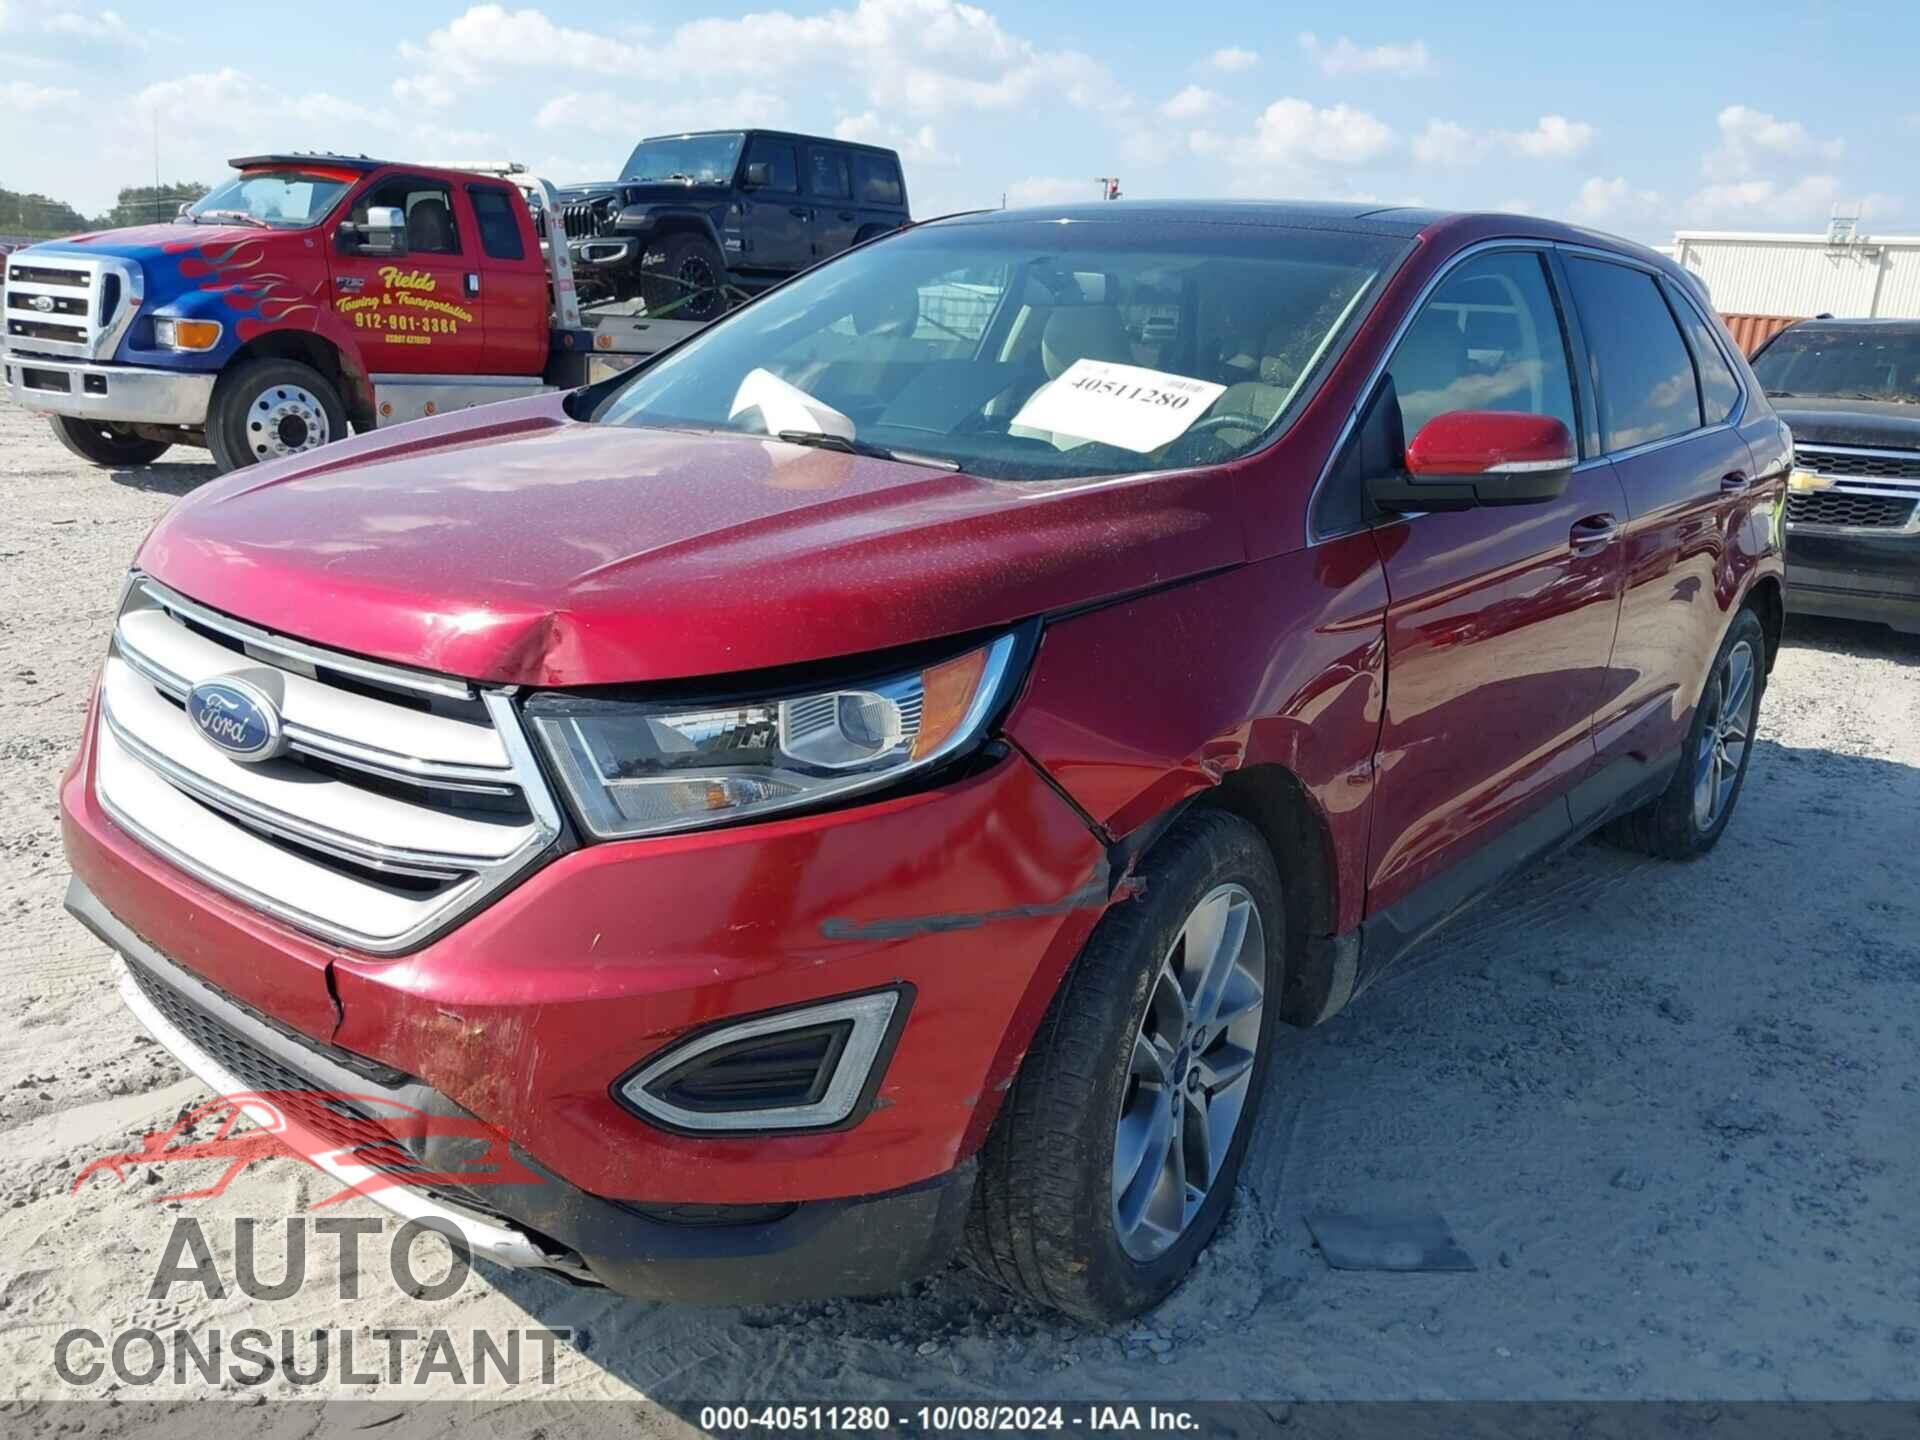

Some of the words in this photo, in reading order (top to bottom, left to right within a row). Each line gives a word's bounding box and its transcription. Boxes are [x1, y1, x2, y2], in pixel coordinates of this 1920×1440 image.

[378, 266, 437, 292] Fields
[336, 296, 379, 312] Towing
[383, 293, 392, 304] &
[396, 291, 473, 323] Transportation
[1071, 376, 1190, 410] 40511280
[200, 693, 249, 743] Ford
